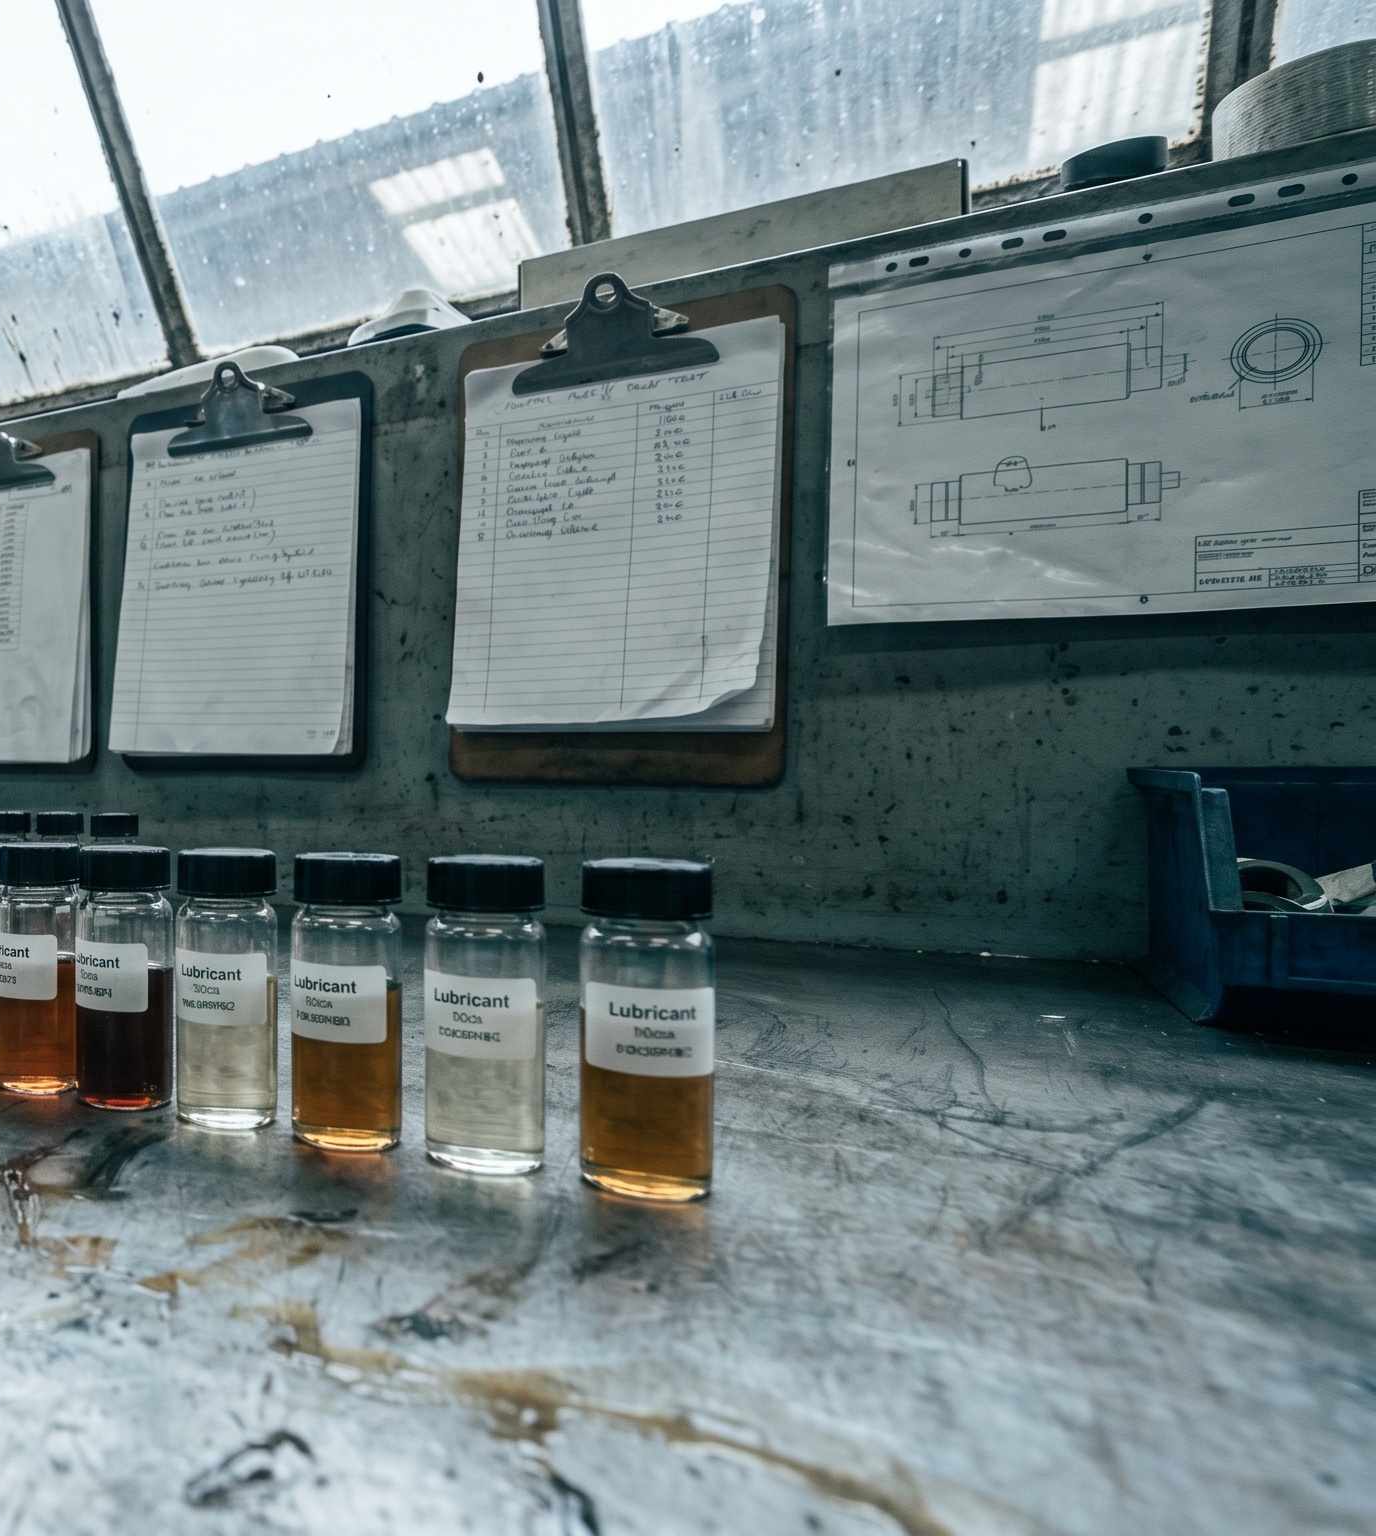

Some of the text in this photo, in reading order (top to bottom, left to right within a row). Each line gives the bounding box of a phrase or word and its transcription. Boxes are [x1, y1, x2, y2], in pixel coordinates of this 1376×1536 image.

[181, 963, 242, 981] Lubricant
[294, 974, 357, 994] Lubricant
[434, 988, 510, 1008] Lubricant
[608, 1001, 697, 1021] Lubricant
